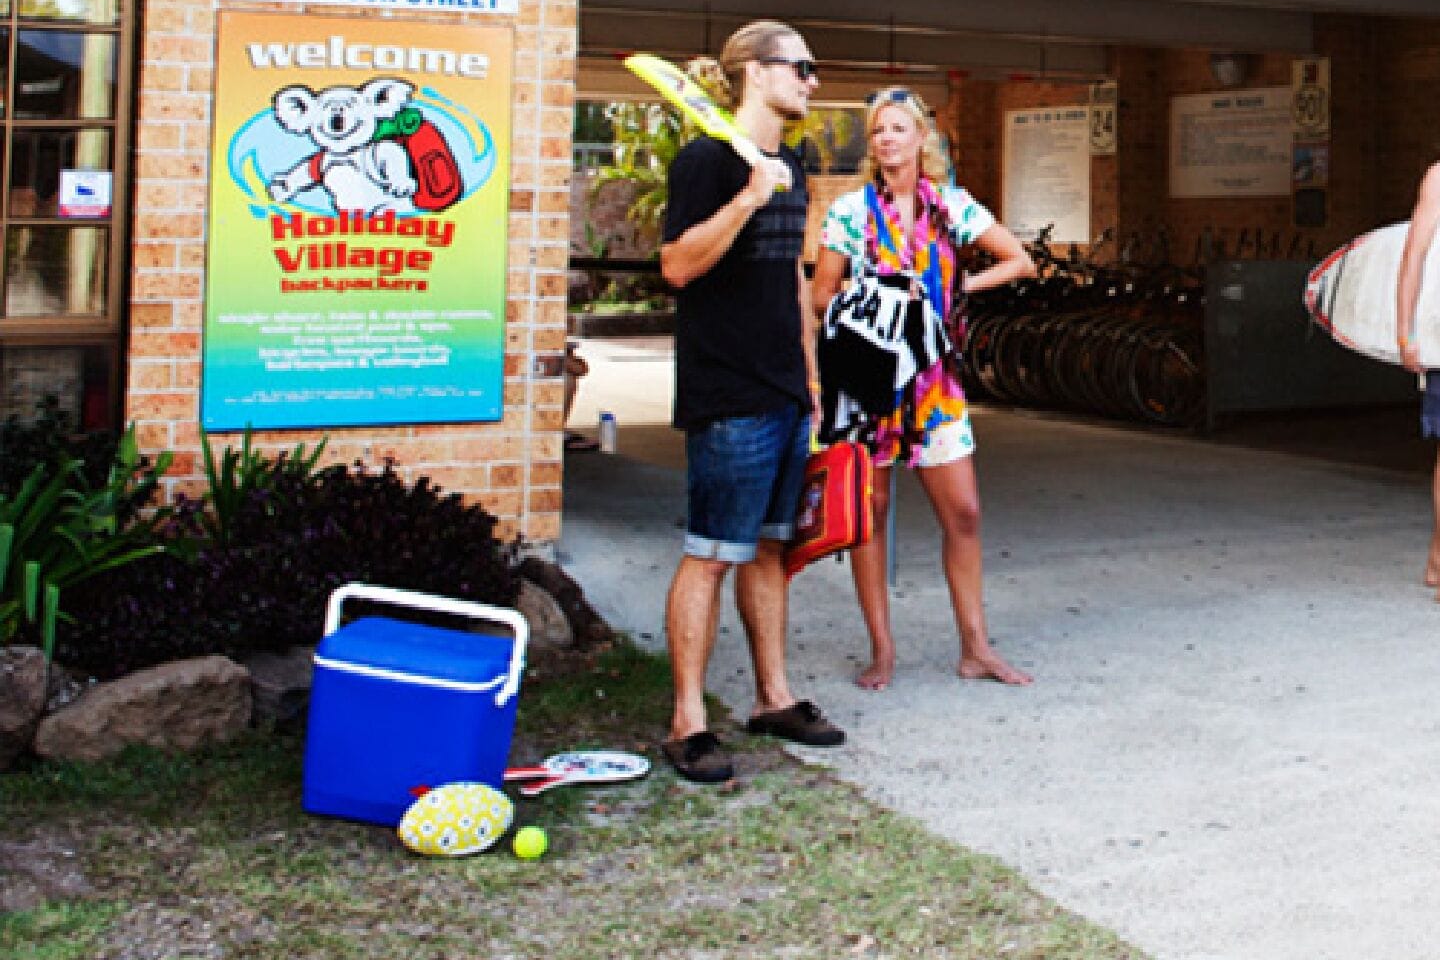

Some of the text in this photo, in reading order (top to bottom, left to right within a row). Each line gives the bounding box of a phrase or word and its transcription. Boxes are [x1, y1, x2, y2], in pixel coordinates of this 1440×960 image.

[246, 36, 490, 78] welcome
[270, 208, 456, 247] Holiday
[274, 241, 433, 276] Village
[280, 277, 428, 293] backpackers
